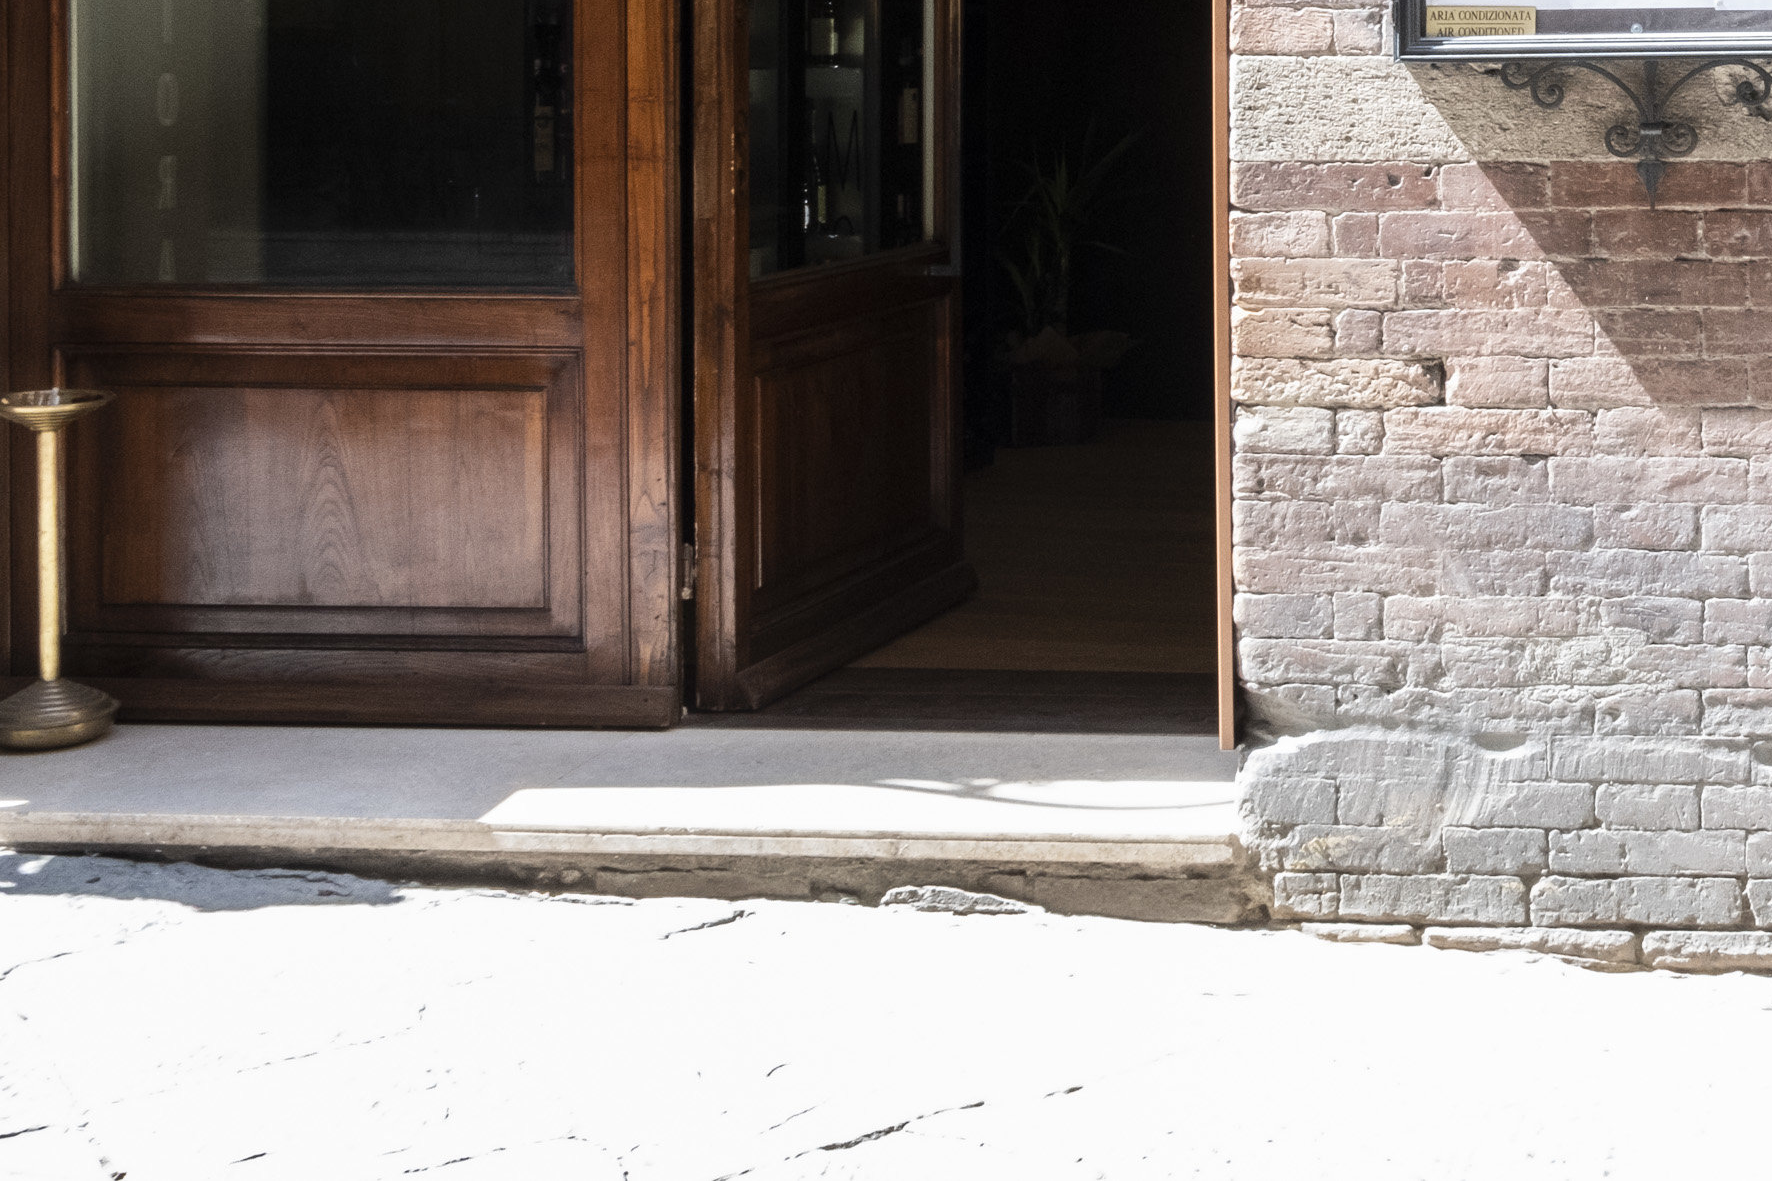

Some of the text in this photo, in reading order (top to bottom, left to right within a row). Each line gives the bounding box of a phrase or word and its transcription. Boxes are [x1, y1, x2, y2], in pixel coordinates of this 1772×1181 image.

[1430, 10, 1532, 21] ARIA CONDIZIONATA
[1437, 26, 1525, 37] AIR CONDITIONED
